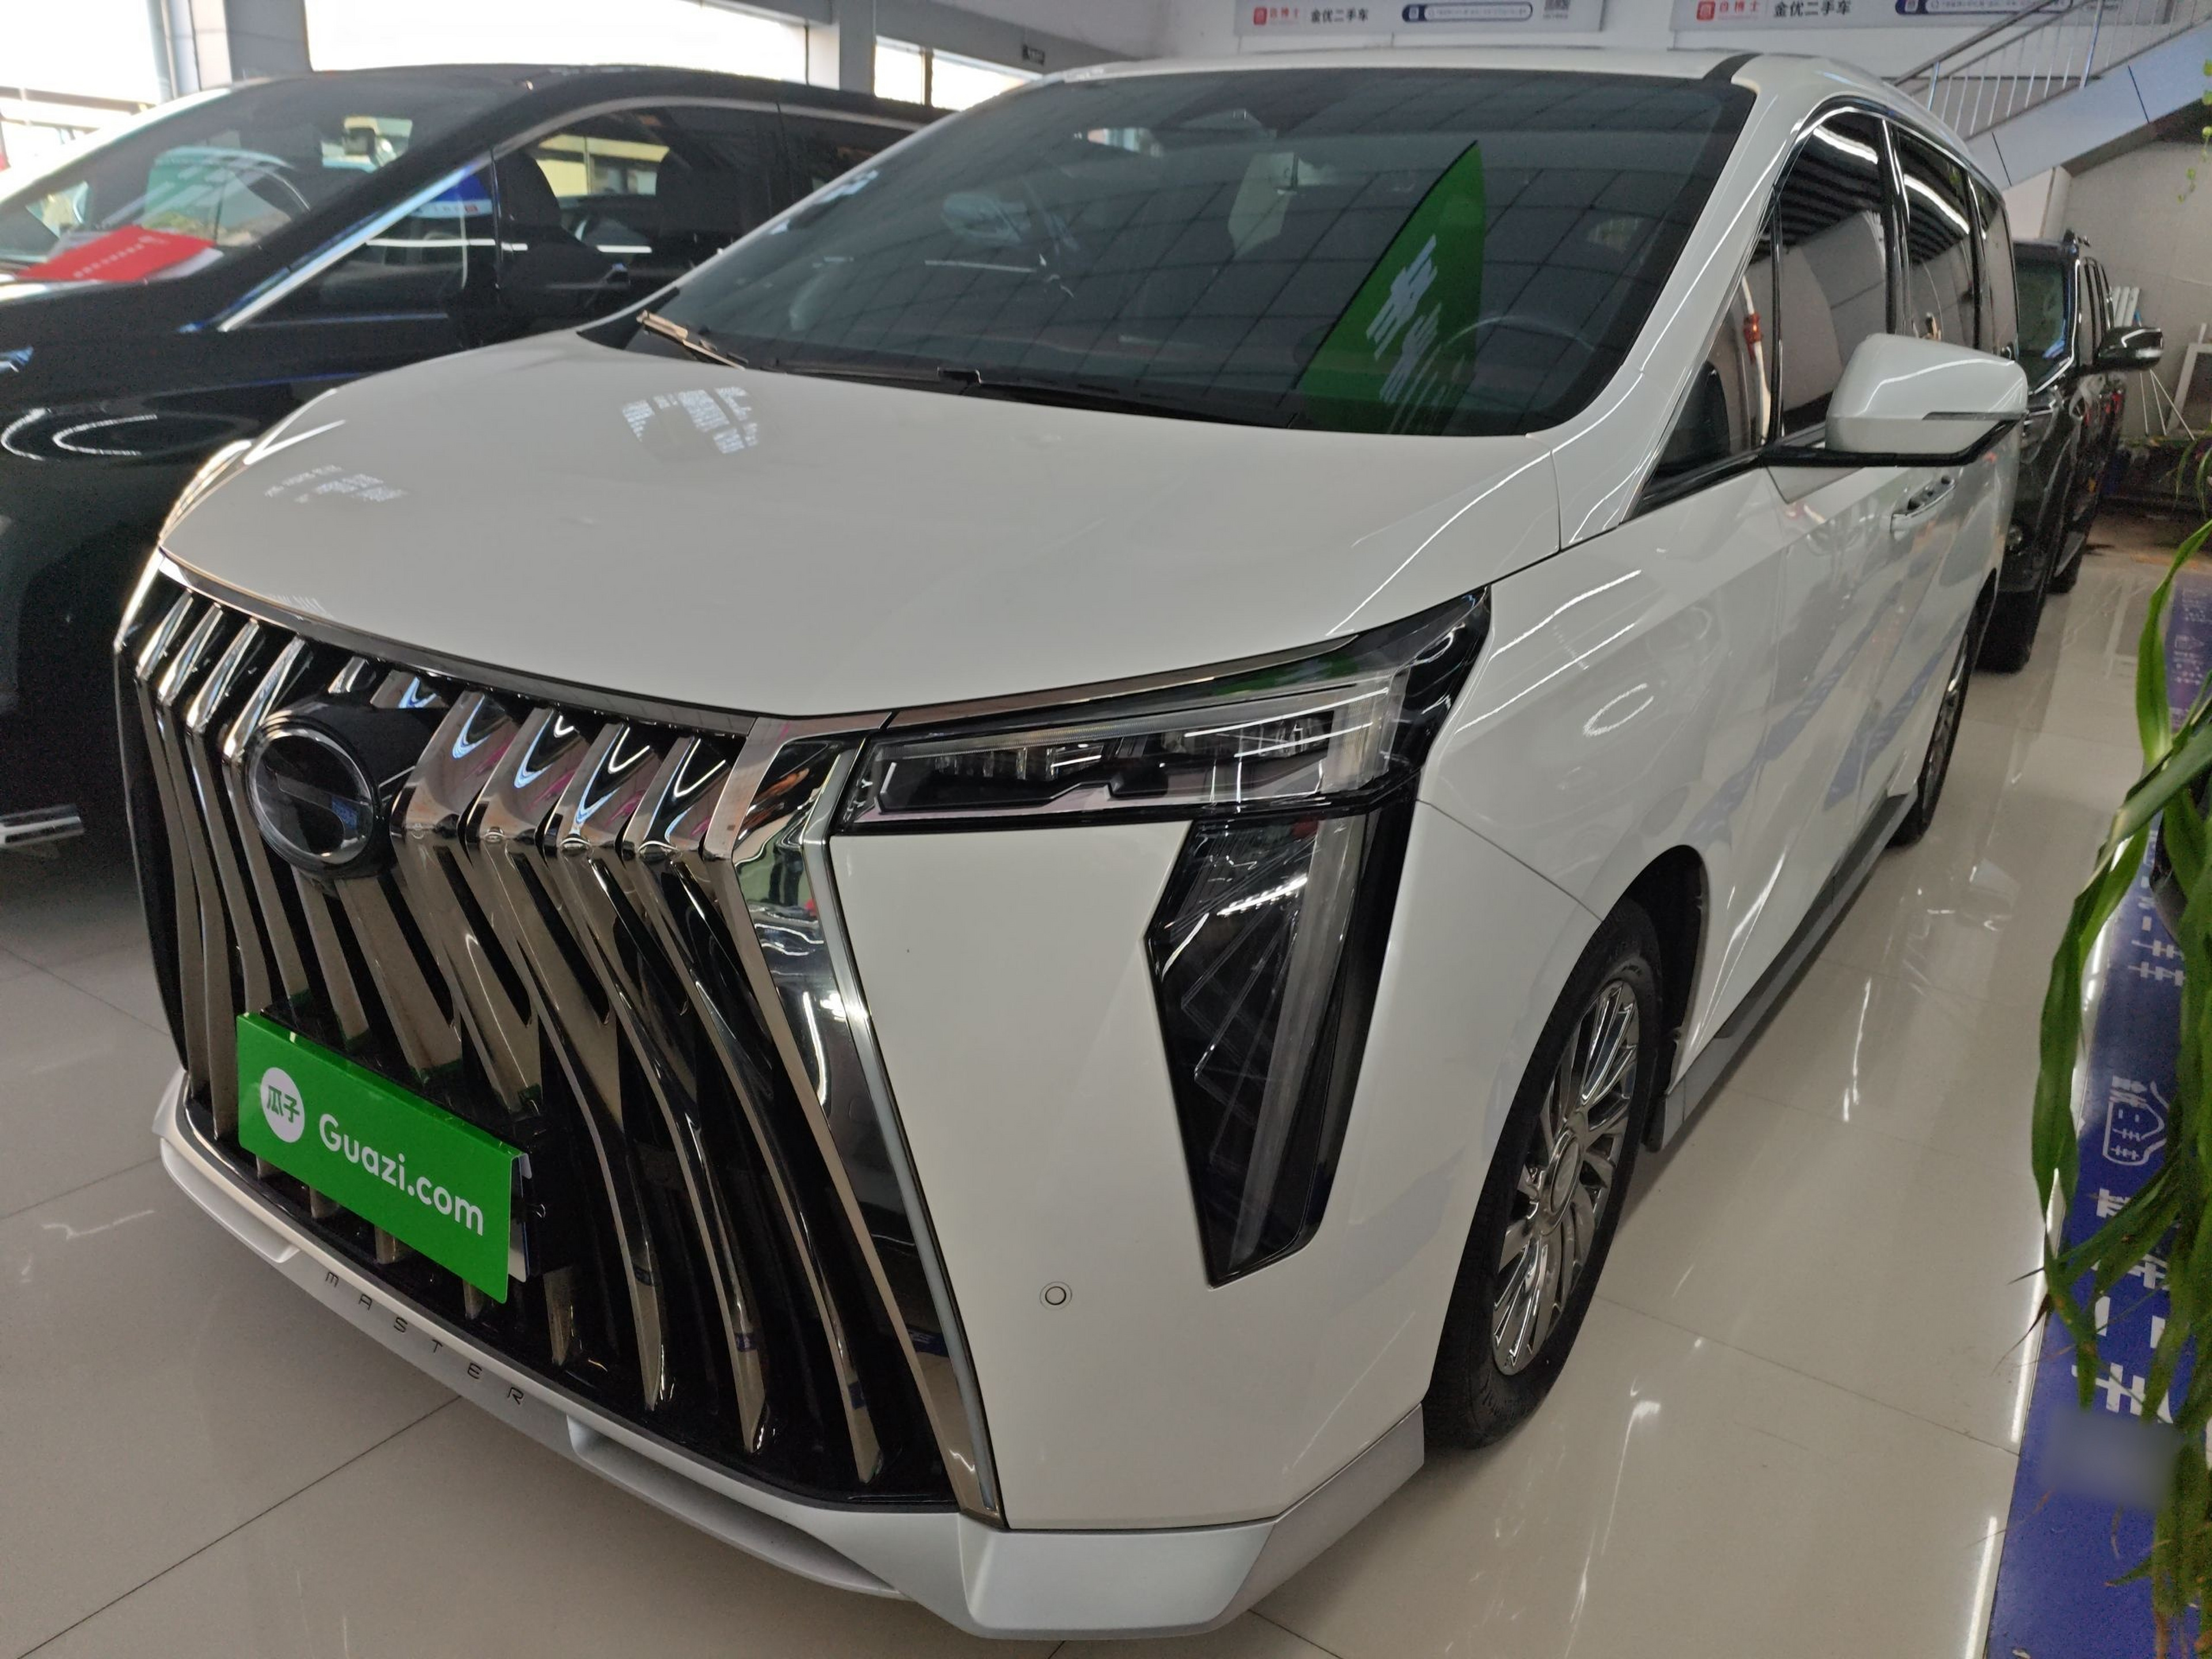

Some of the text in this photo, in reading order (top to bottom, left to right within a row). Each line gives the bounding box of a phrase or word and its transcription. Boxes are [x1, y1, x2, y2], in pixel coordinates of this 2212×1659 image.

[1774, 1, 1851, 17] 金优二手车
[267, 1085, 300, 1123] 瓜子
[319, 1113, 484, 1236] Guazi.com
[325, 1271, 524, 1405] MASTER
